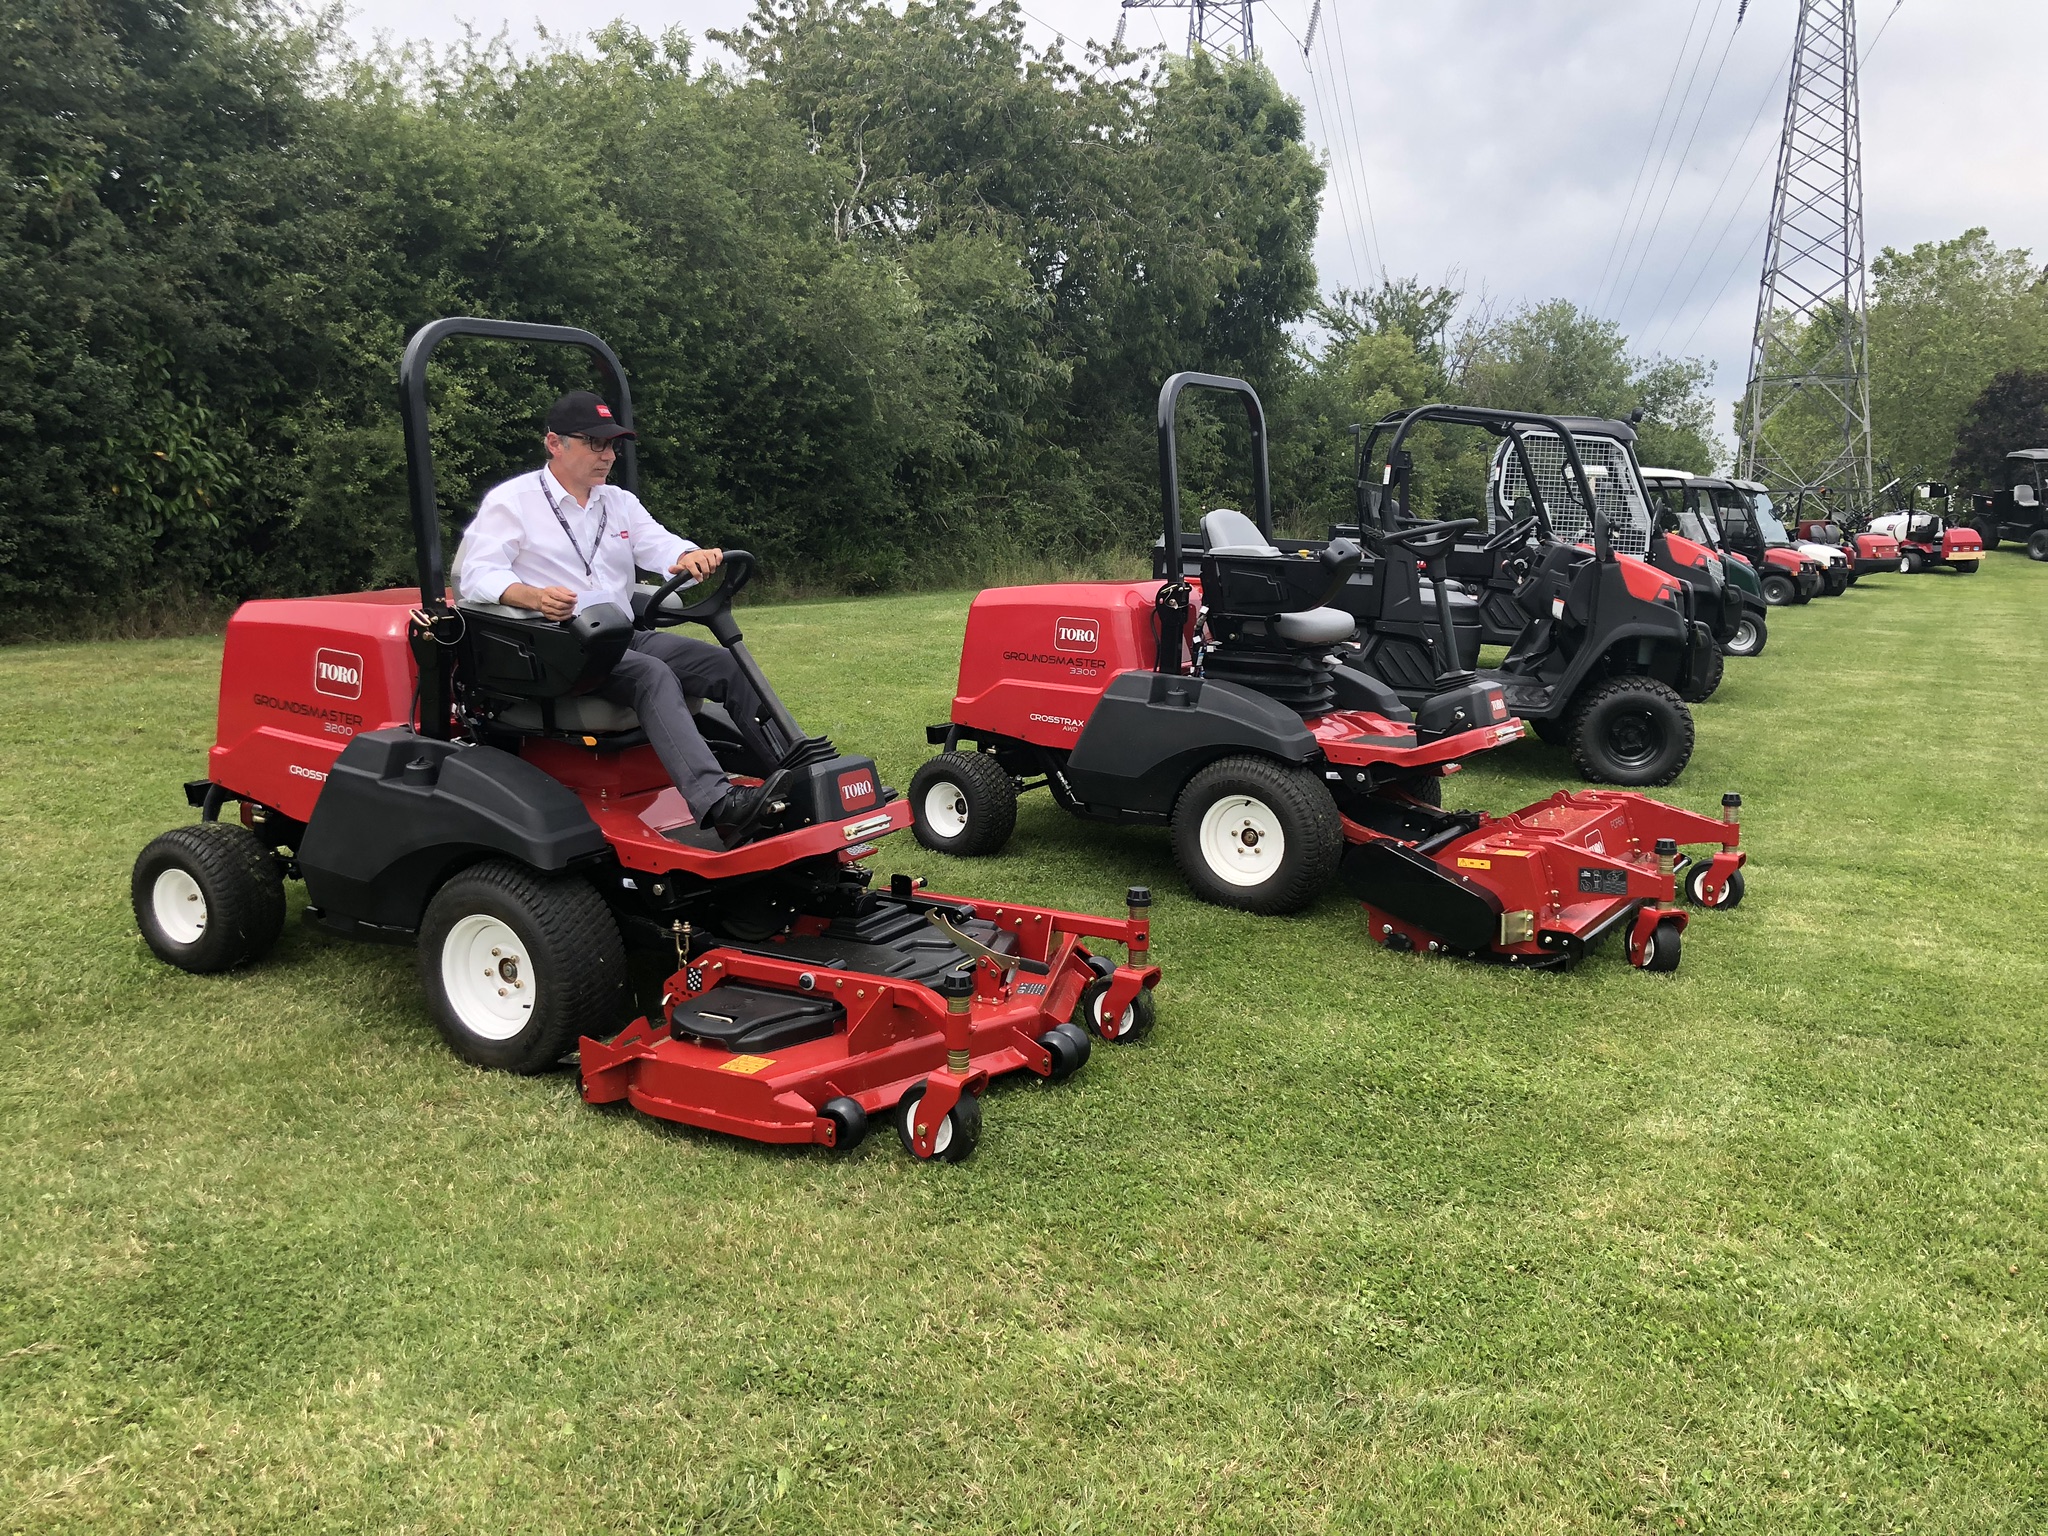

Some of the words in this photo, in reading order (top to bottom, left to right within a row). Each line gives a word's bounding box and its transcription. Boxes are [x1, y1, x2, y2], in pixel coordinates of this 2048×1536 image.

[1059, 627, 1096, 643] TORO
[1003, 651, 1107, 669] GROUNDSMASTER
[319, 662, 359, 685] TORO
[1069, 667, 1097, 677] 3300
[254, 694, 362, 726] GROUNDSMASTER
[324, 722, 353, 736] 3200
[1029, 713, 1085, 728] CROSSTRAX
[842, 780, 873, 800] TORO
